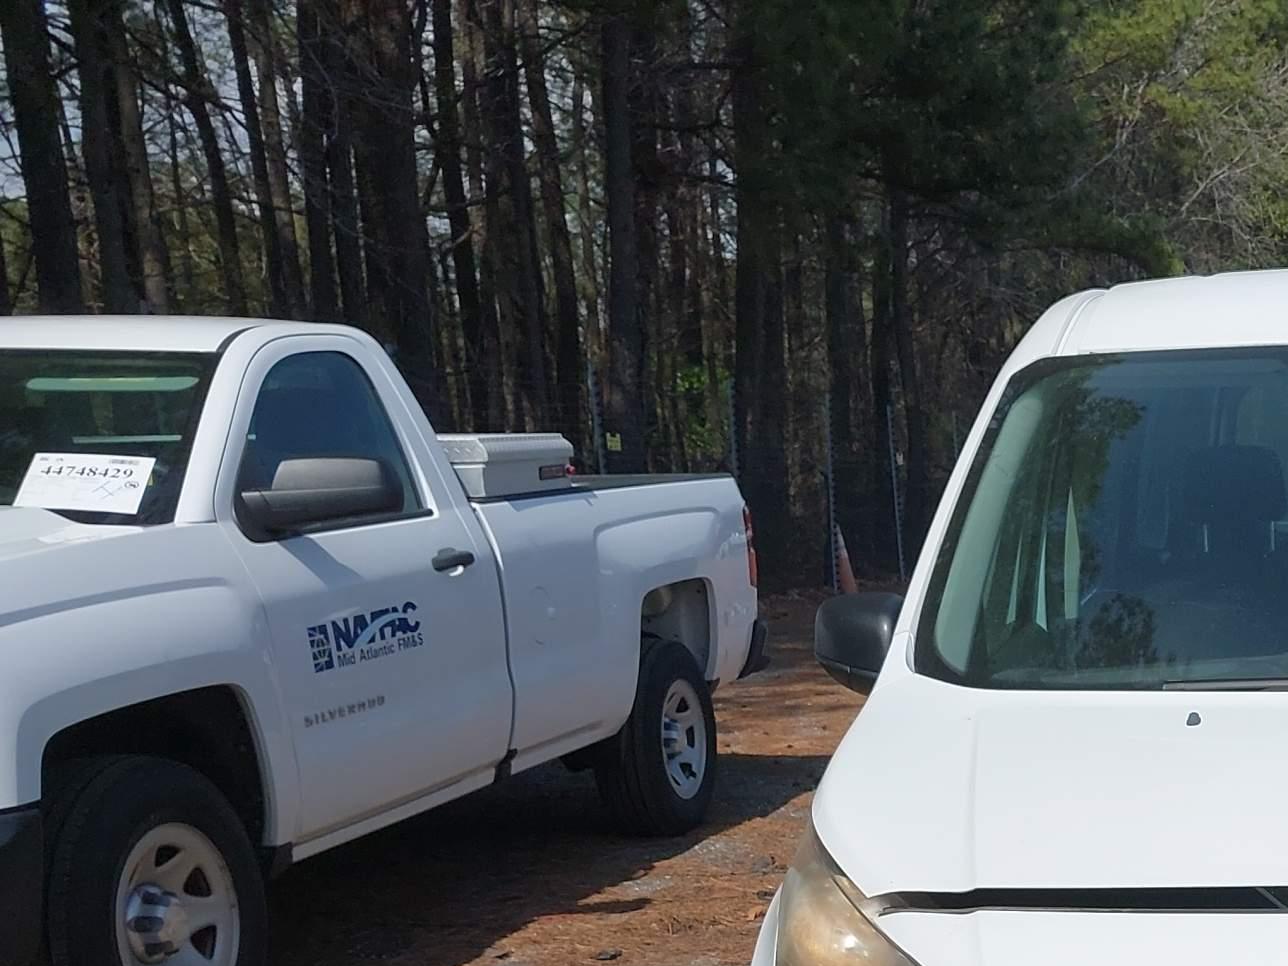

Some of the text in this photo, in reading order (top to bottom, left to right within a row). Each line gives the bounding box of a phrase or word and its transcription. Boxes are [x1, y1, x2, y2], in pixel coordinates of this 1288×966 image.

[40, 465, 134, 479] 44748429
[337, 652, 357, 668] Mid
[360, 643, 395, 664] Atlantic
